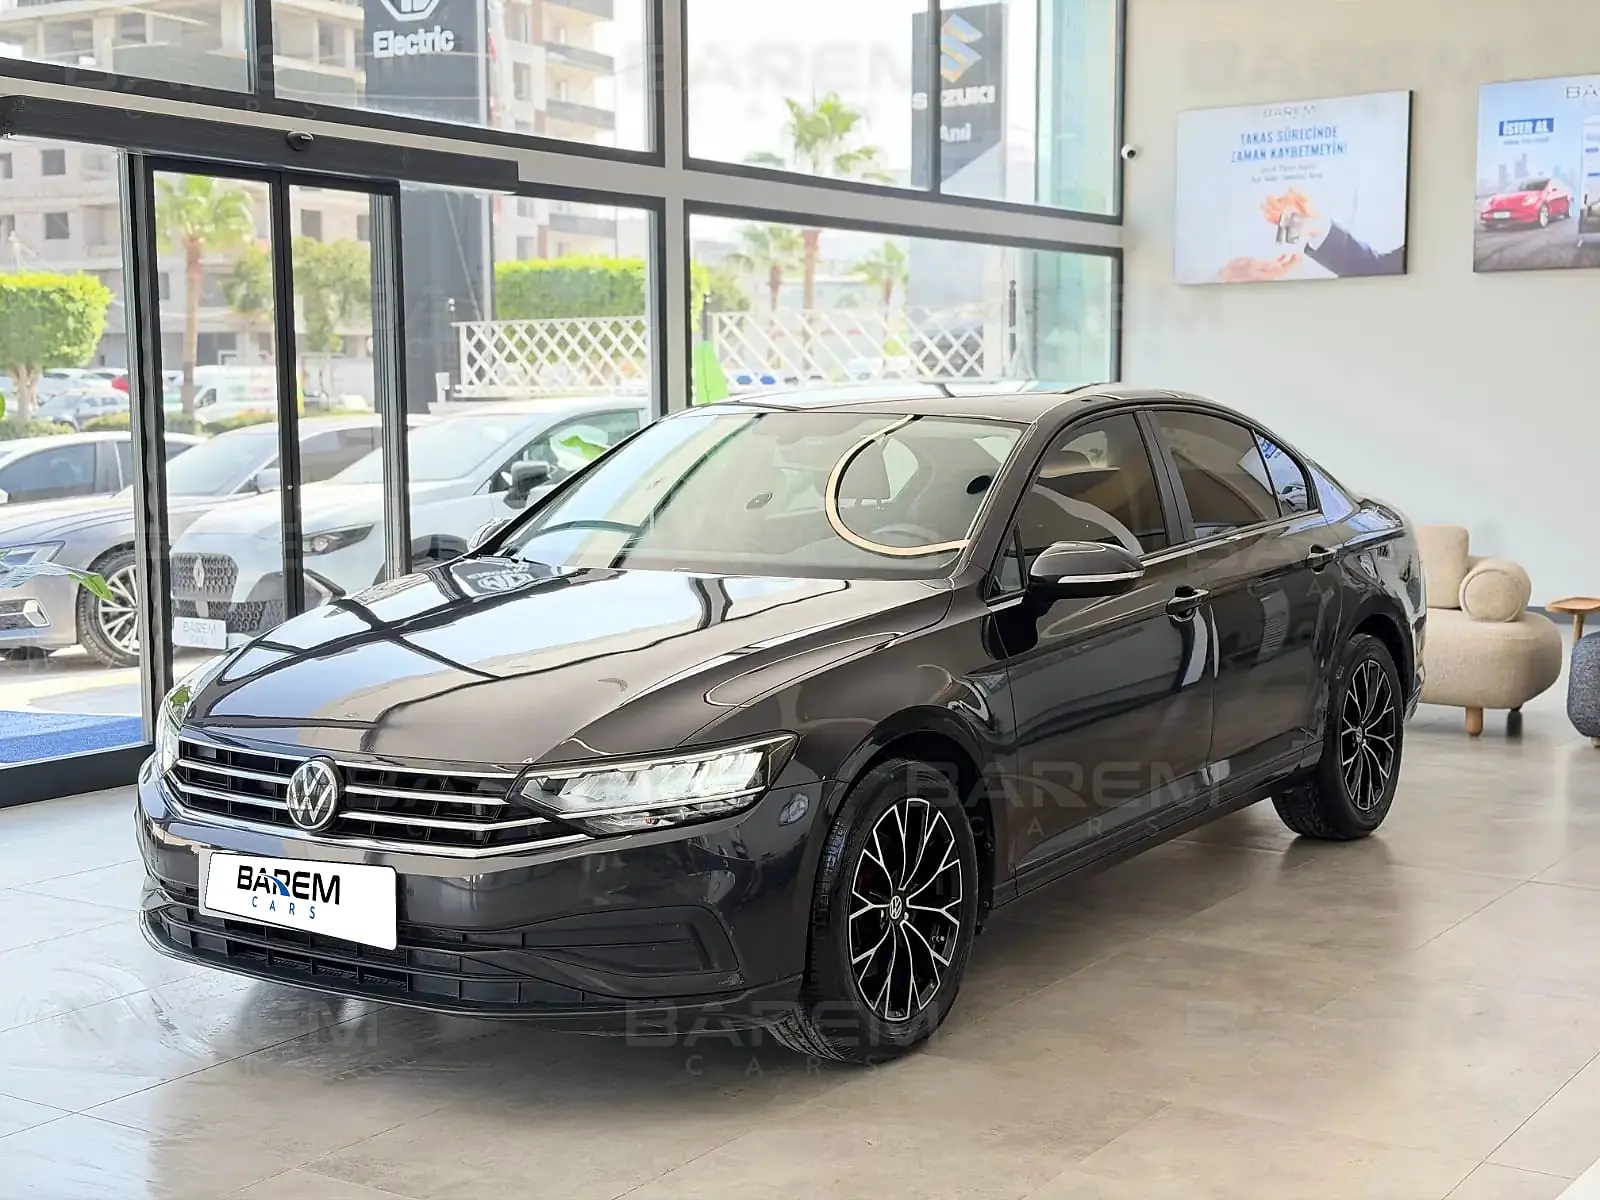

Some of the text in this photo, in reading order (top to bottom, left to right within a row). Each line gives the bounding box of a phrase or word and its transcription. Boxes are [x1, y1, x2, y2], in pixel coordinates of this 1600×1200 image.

[373, 24, 454, 58] Electric
[912, 85, 995, 110] SZUKI
[1535, 119, 1550, 133] AL
[1241, 131, 1274, 145] TAKAS
[1231, 148, 1266, 163] ZAMAN
[237, 865, 340, 905] BAREM
[252, 896, 316, 919] CARS
